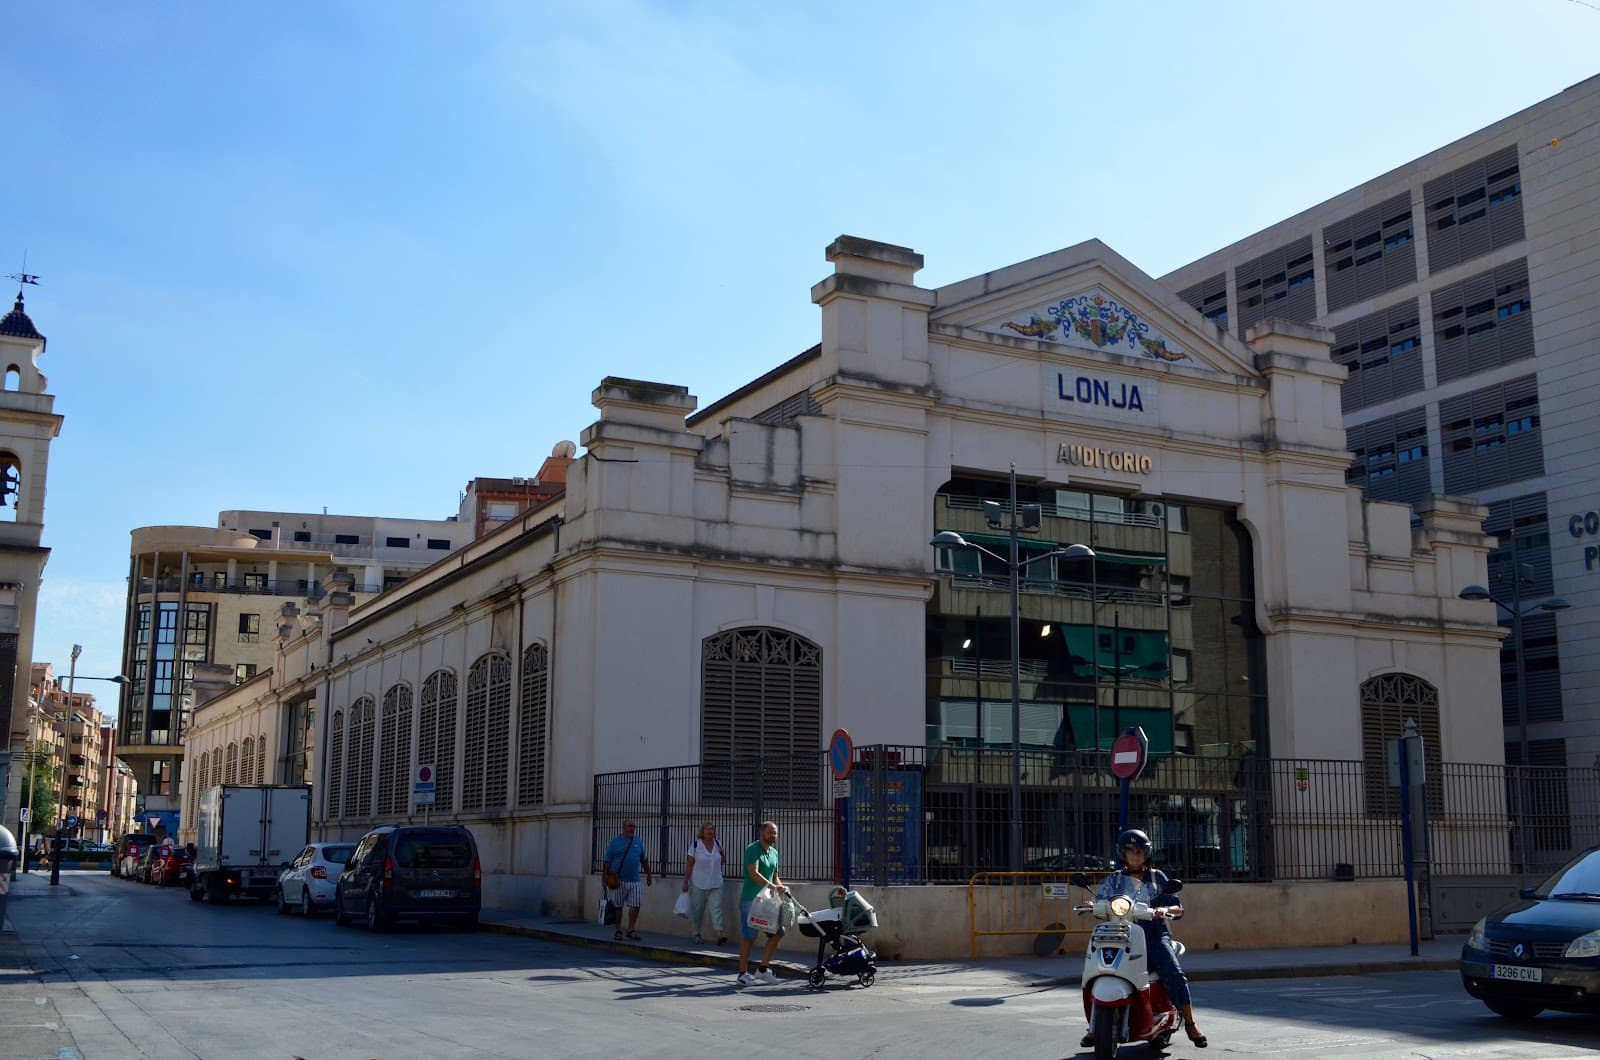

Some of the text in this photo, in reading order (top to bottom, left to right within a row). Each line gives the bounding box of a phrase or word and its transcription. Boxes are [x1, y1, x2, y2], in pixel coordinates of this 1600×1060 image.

[1058, 373, 1144, 412] LONJA
[1056, 443, 1152, 475] AUDITORIO
[1584, 545, 1600, 571] P
[1496, 966, 1539, 981] 3296 CVL
